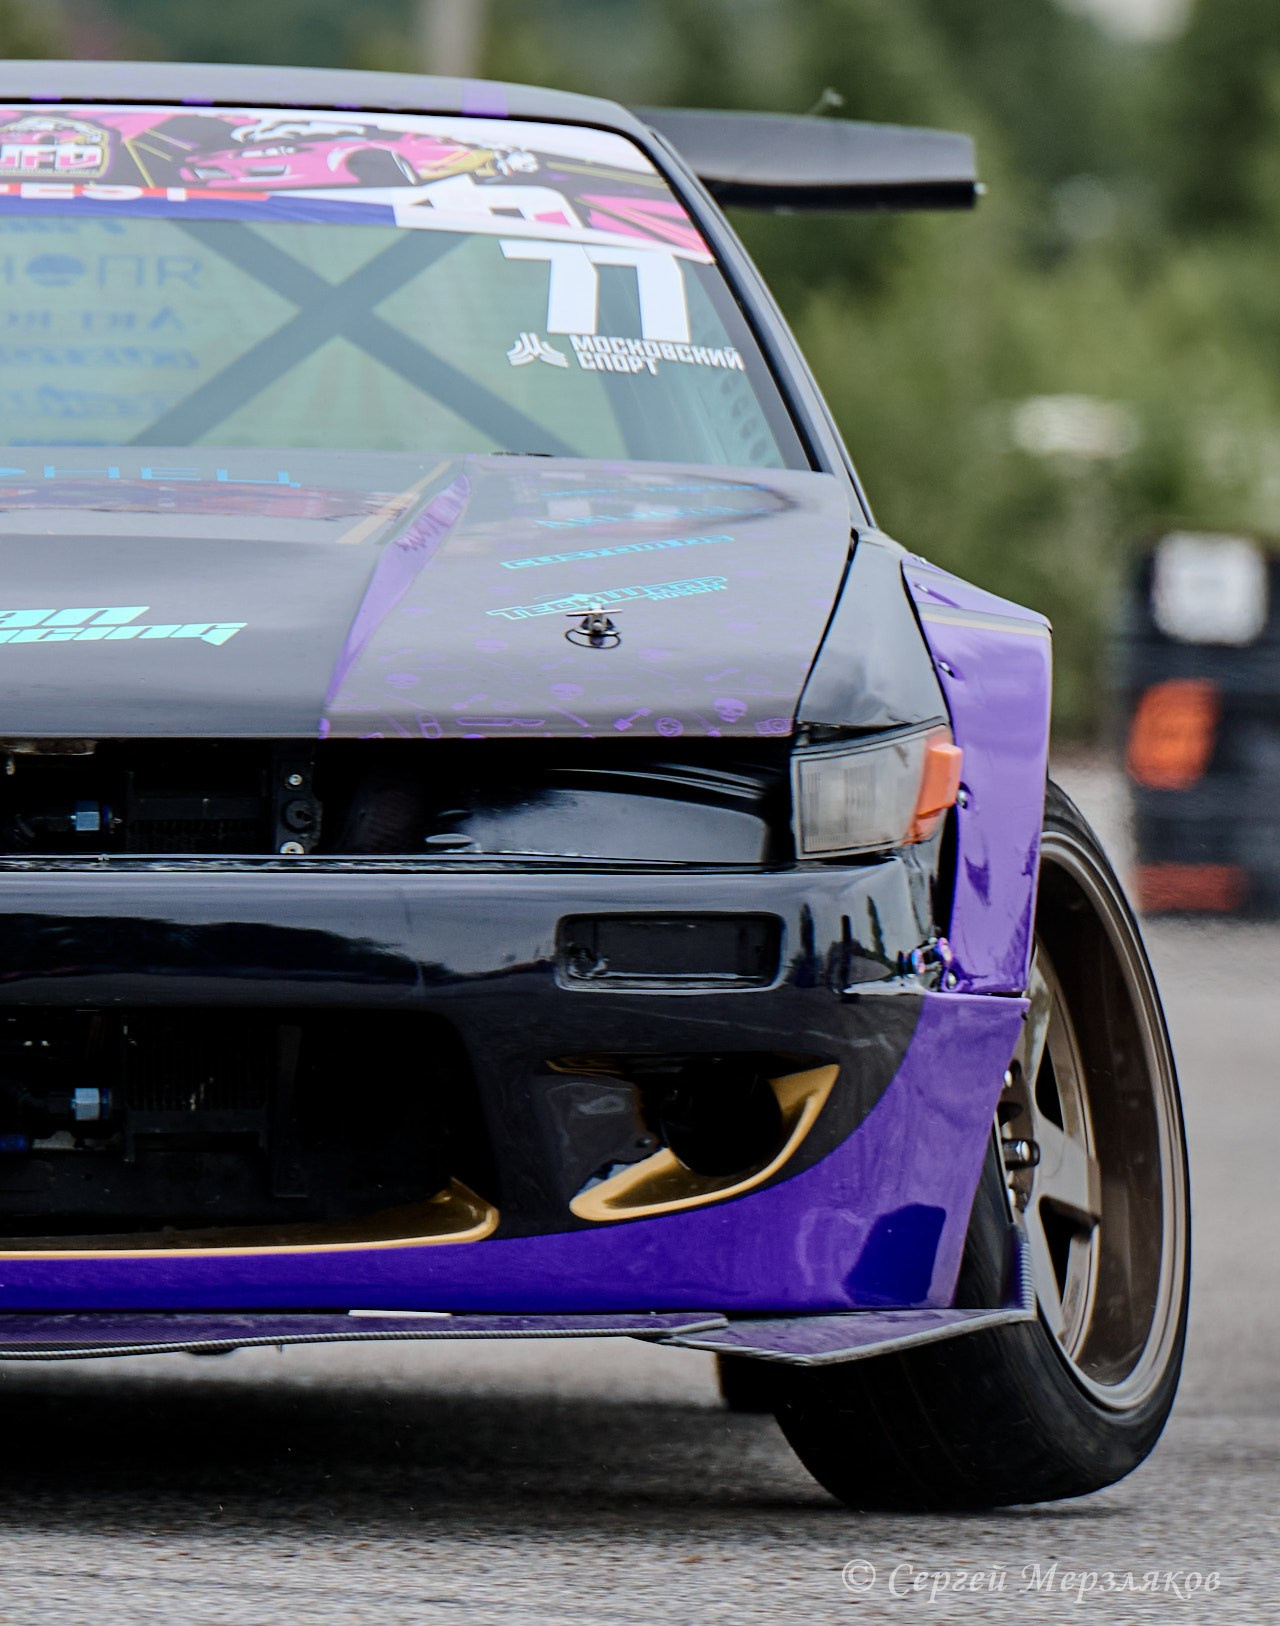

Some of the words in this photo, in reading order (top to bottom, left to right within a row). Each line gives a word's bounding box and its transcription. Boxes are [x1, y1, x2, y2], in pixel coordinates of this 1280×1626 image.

[499, 239, 690, 344] 77
[570, 335, 745, 371] МОСКОВСКИЙ
[578, 351, 658, 376] СПОРТ
